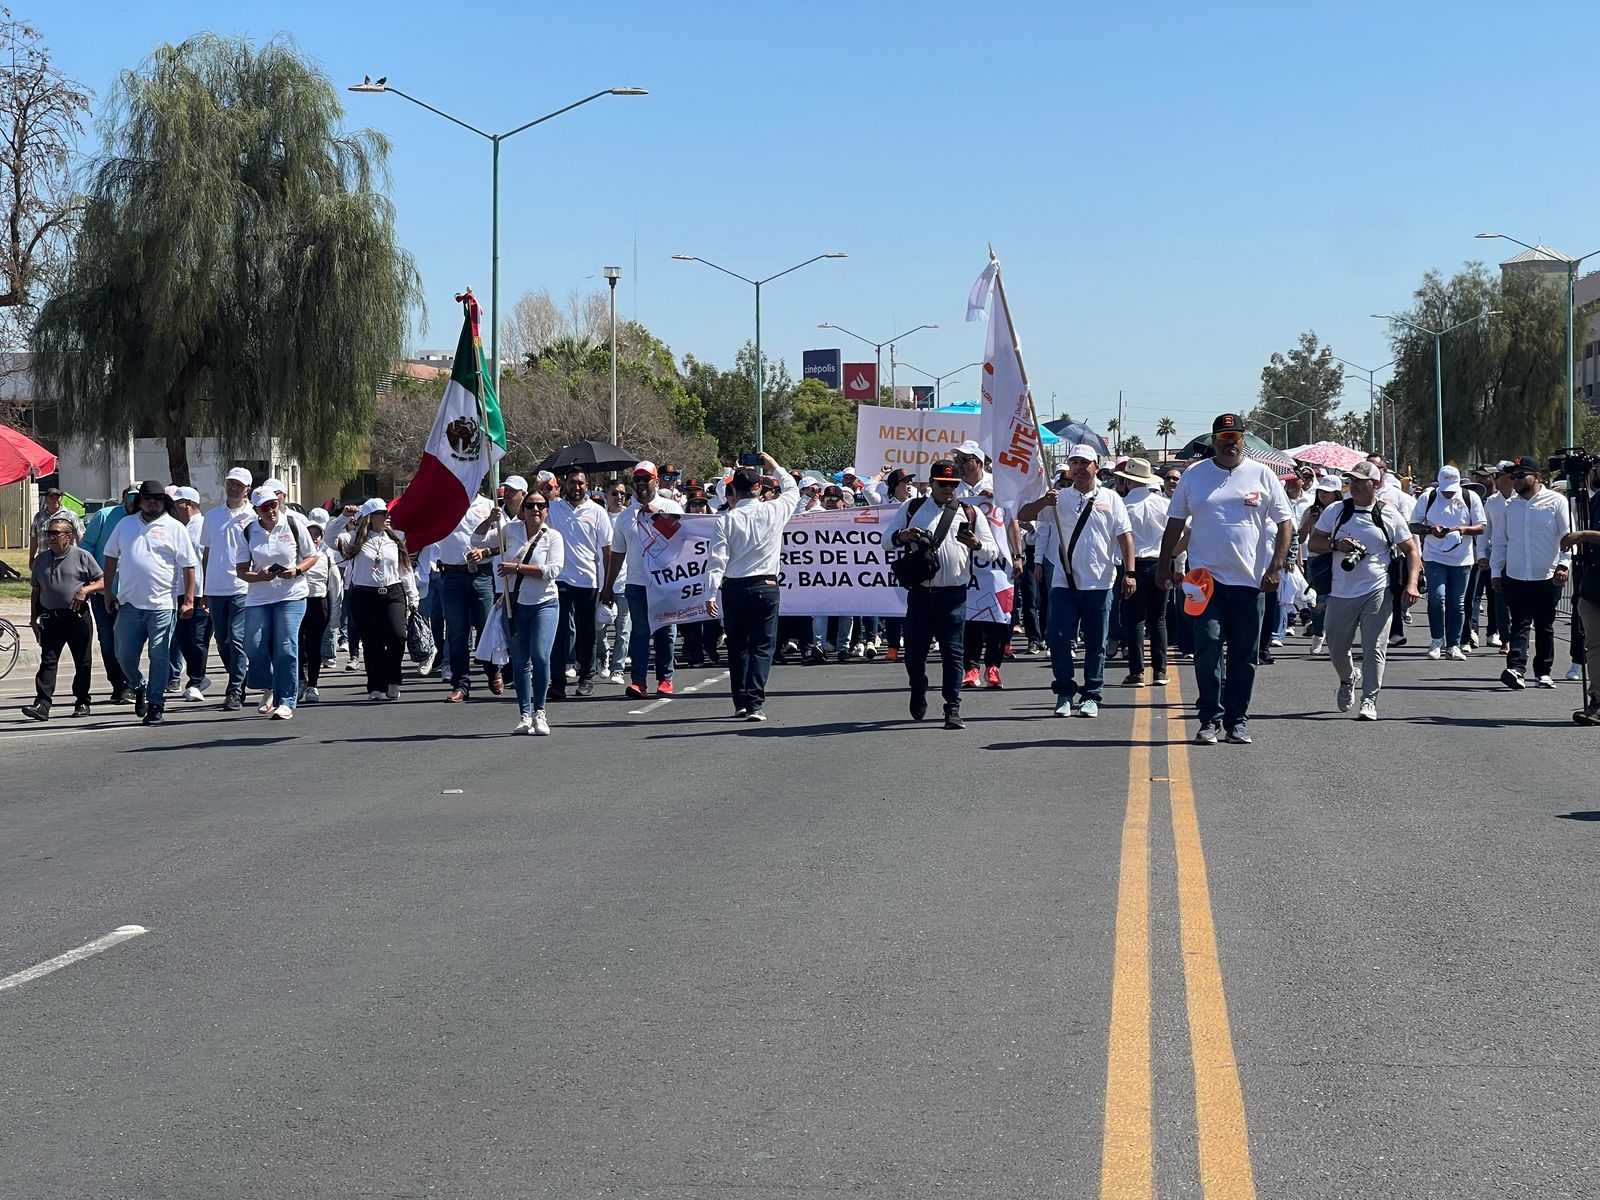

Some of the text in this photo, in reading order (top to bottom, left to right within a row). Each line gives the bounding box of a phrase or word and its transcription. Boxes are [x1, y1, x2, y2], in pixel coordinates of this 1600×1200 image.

[804, 363, 835, 374] cinépolis
[878, 425, 966, 443] MEXICALI
[998, 422, 1037, 475] SNTE
[819, 550, 848, 565] DE
[853, 550, 880, 565] LA
[798, 571, 854, 588] BAJA
